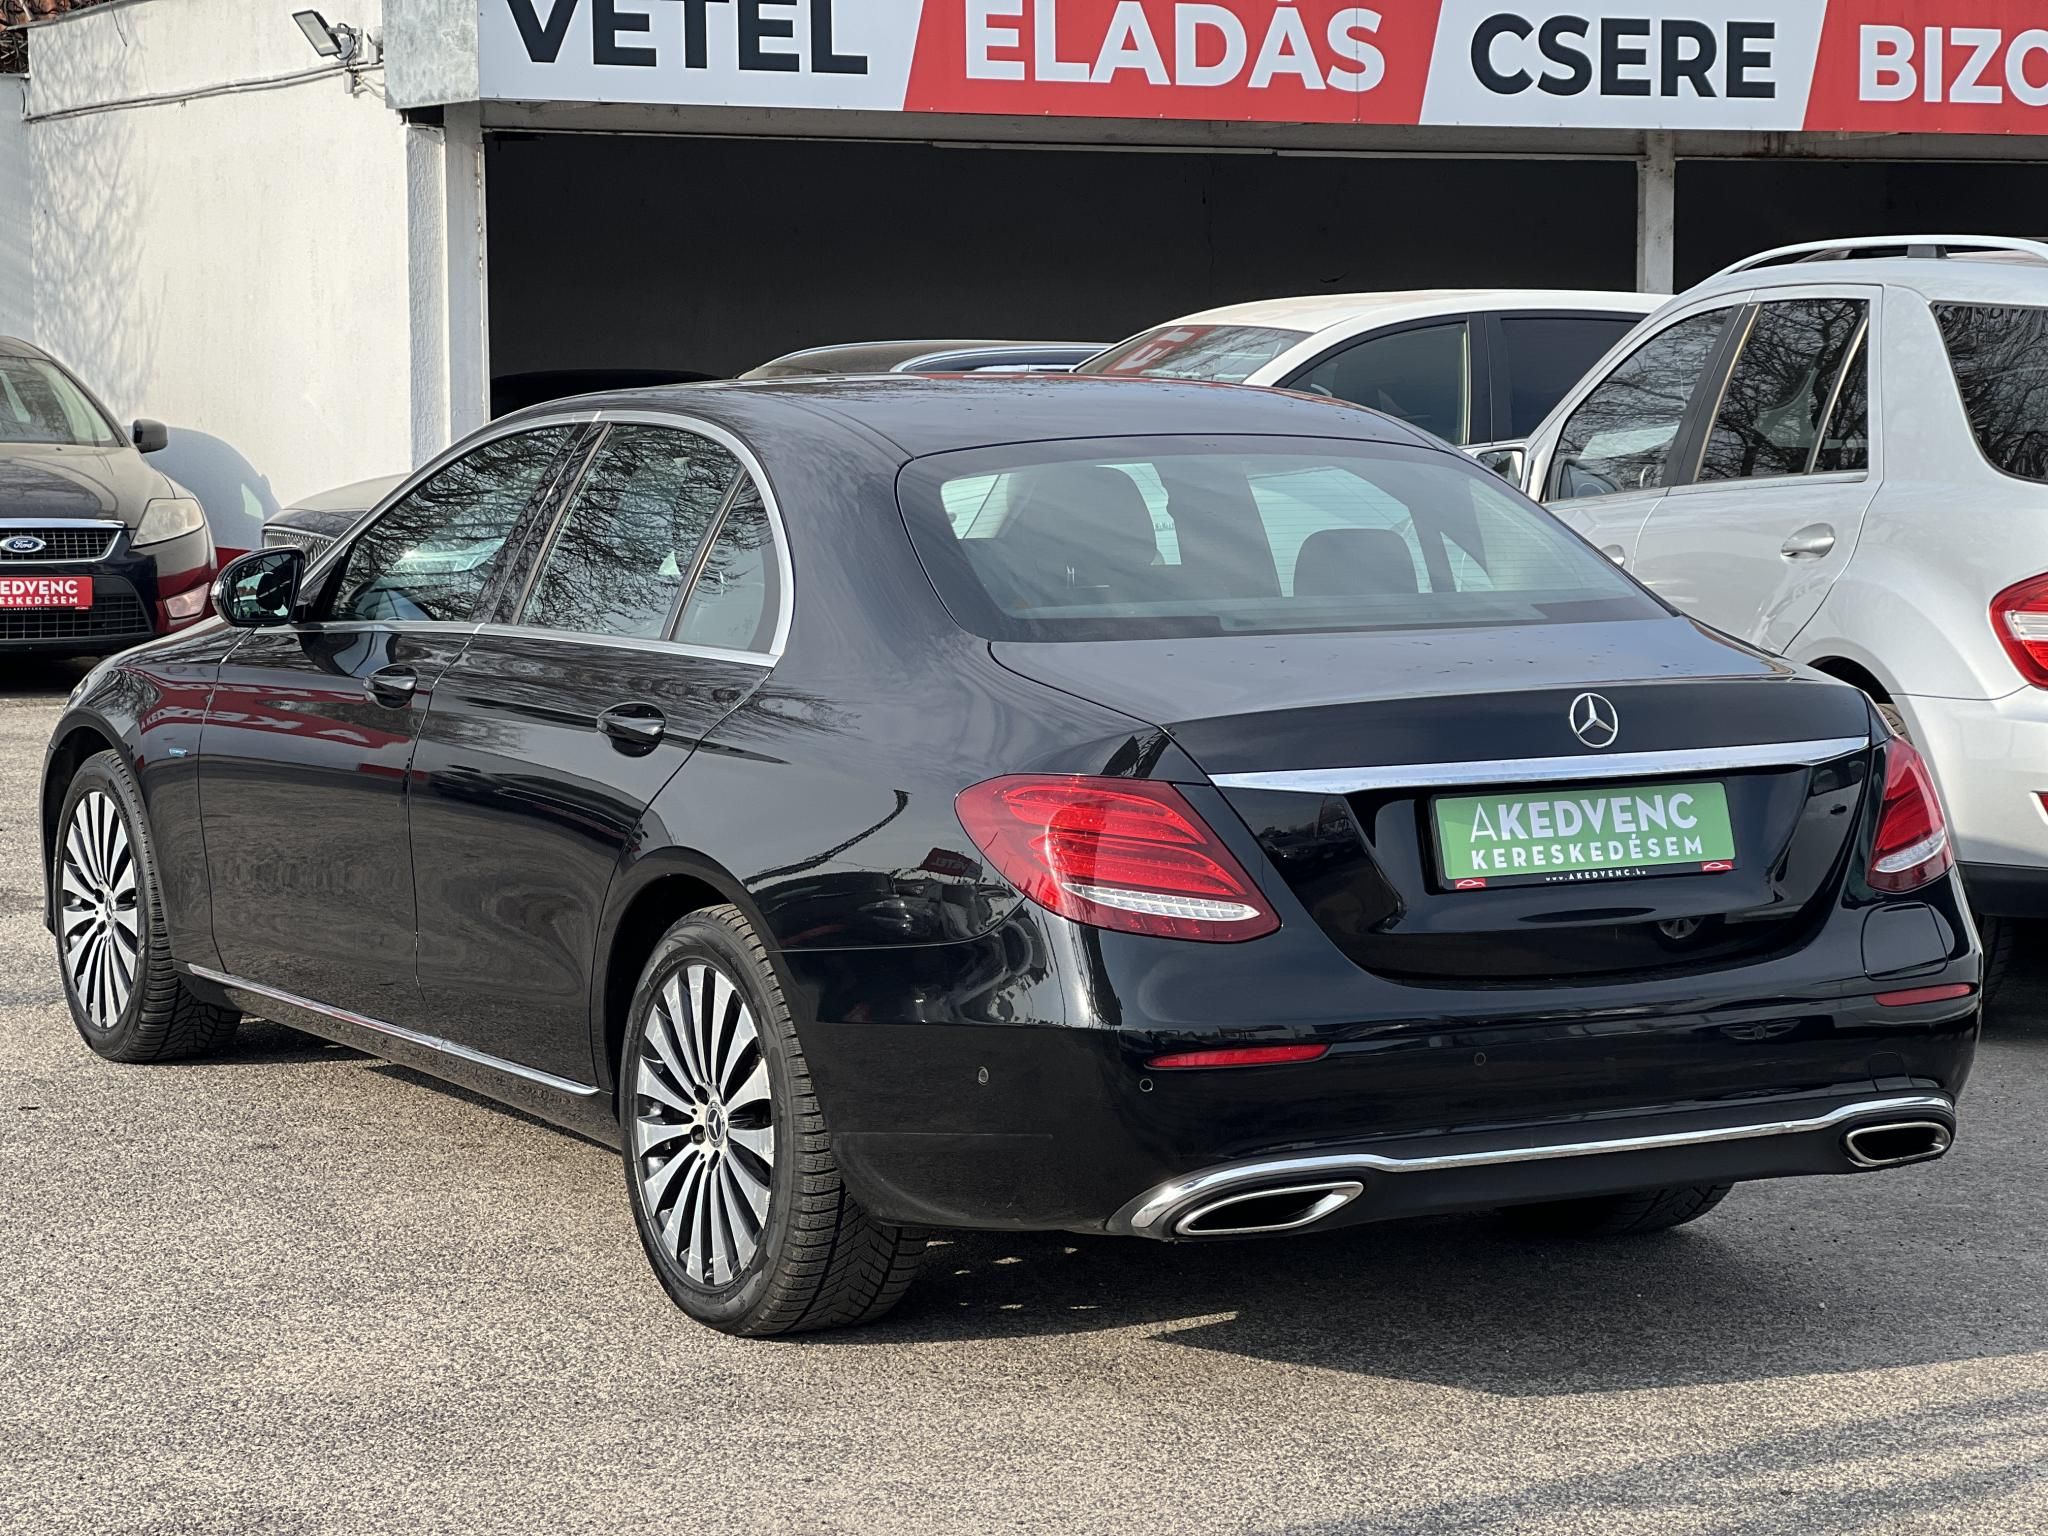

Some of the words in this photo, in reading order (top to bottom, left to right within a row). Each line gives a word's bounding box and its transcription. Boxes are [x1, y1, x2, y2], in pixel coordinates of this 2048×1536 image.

[1470, 12, 1776, 99] CSERE
[13, 540, 34, 549] Ford
[0, 580, 78, 594] EDVENC
[1471, 834, 1703, 870] KERESKEDÉSEM
